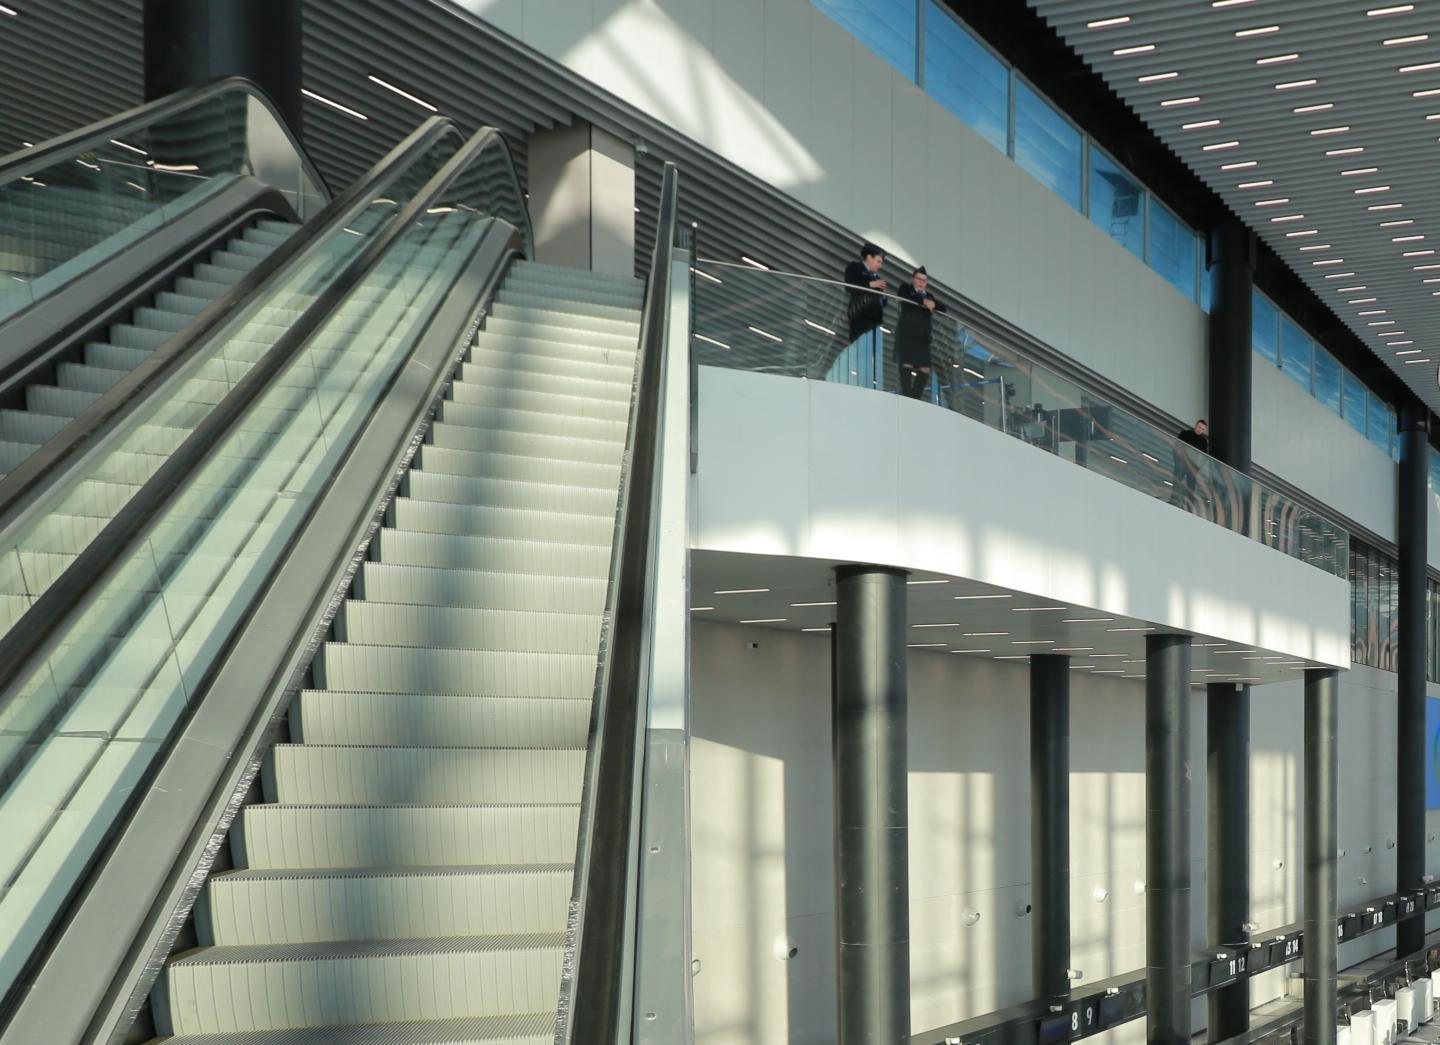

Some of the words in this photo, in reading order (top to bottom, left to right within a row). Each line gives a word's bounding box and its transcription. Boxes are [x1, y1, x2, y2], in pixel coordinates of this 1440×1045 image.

[1292, 939, 1299, 954] 14
[1229, 959, 1236, 976] 11
[1238, 957, 1246, 973] 12
[1071, 1011, 1079, 1031] 8
[1086, 1006, 1093, 1025] 9
